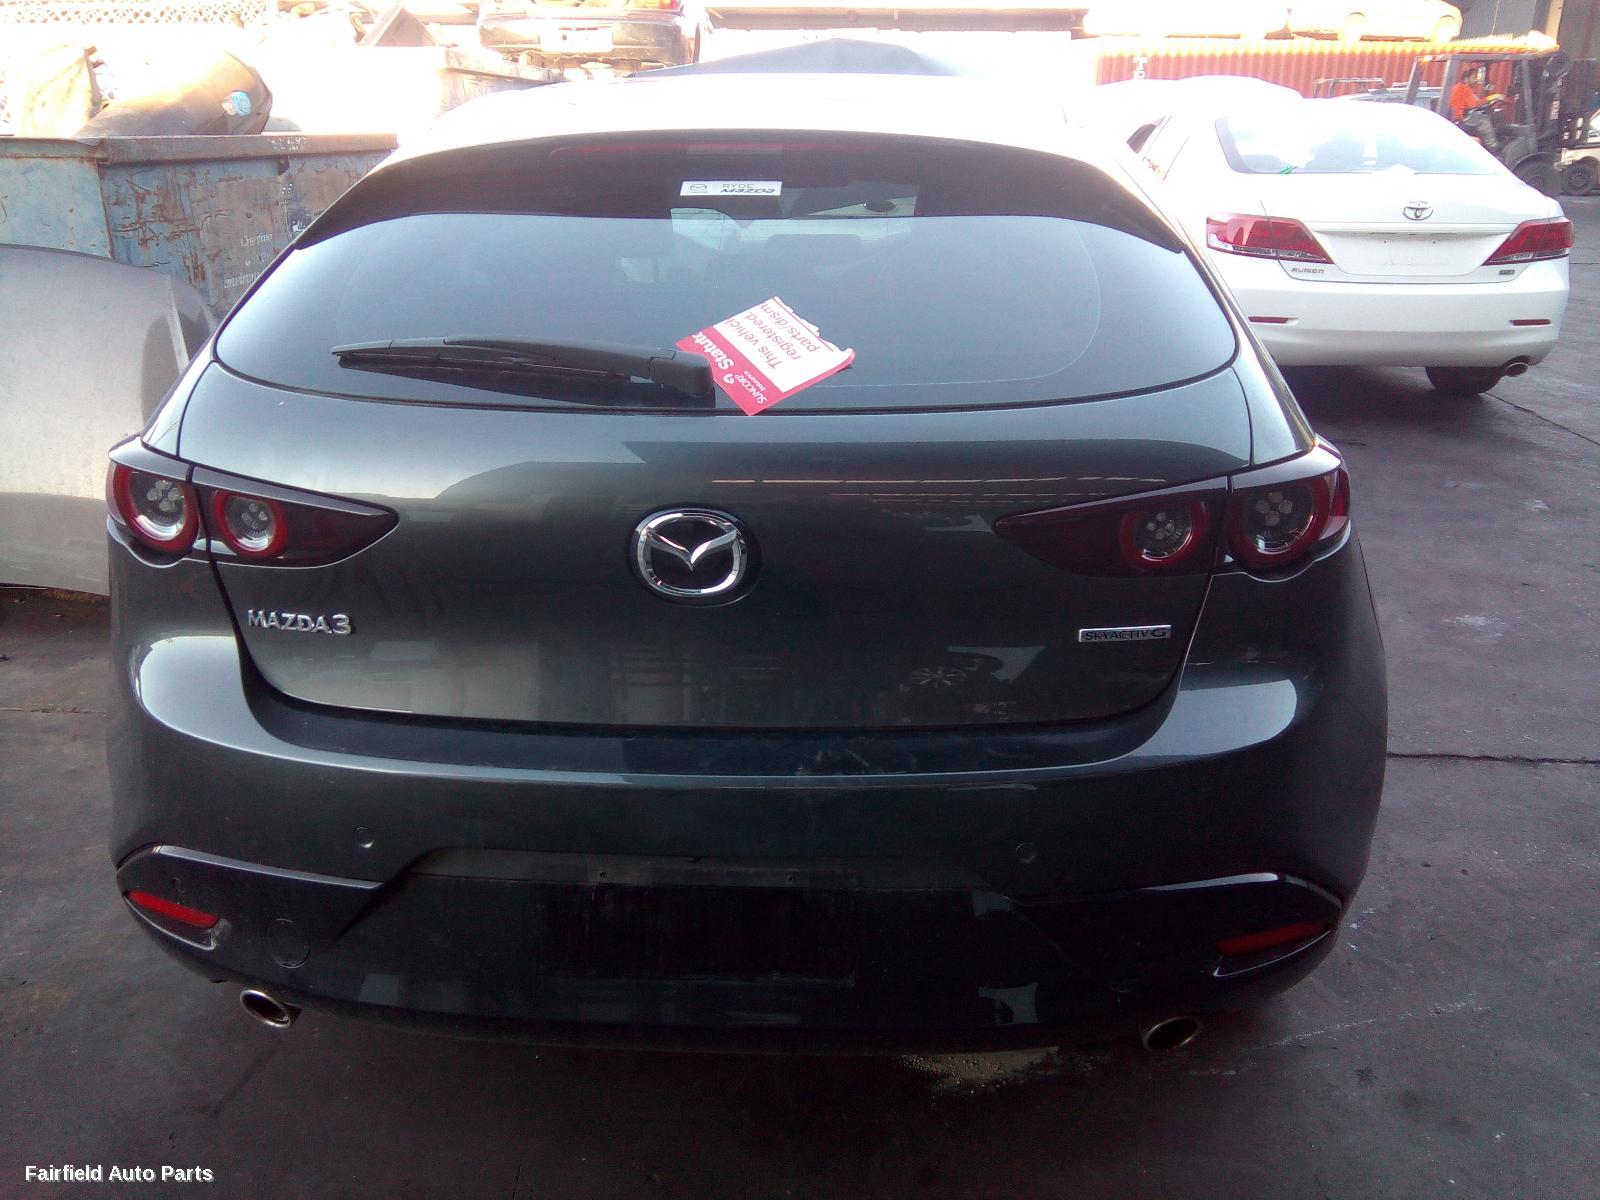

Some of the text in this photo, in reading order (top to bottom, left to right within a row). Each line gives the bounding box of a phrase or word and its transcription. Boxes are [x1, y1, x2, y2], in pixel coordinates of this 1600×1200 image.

[758, 345, 783, 370] This
[734, 373, 768, 404] SUNCORP
[1084, 629, 1148, 641] SKYACTIV
